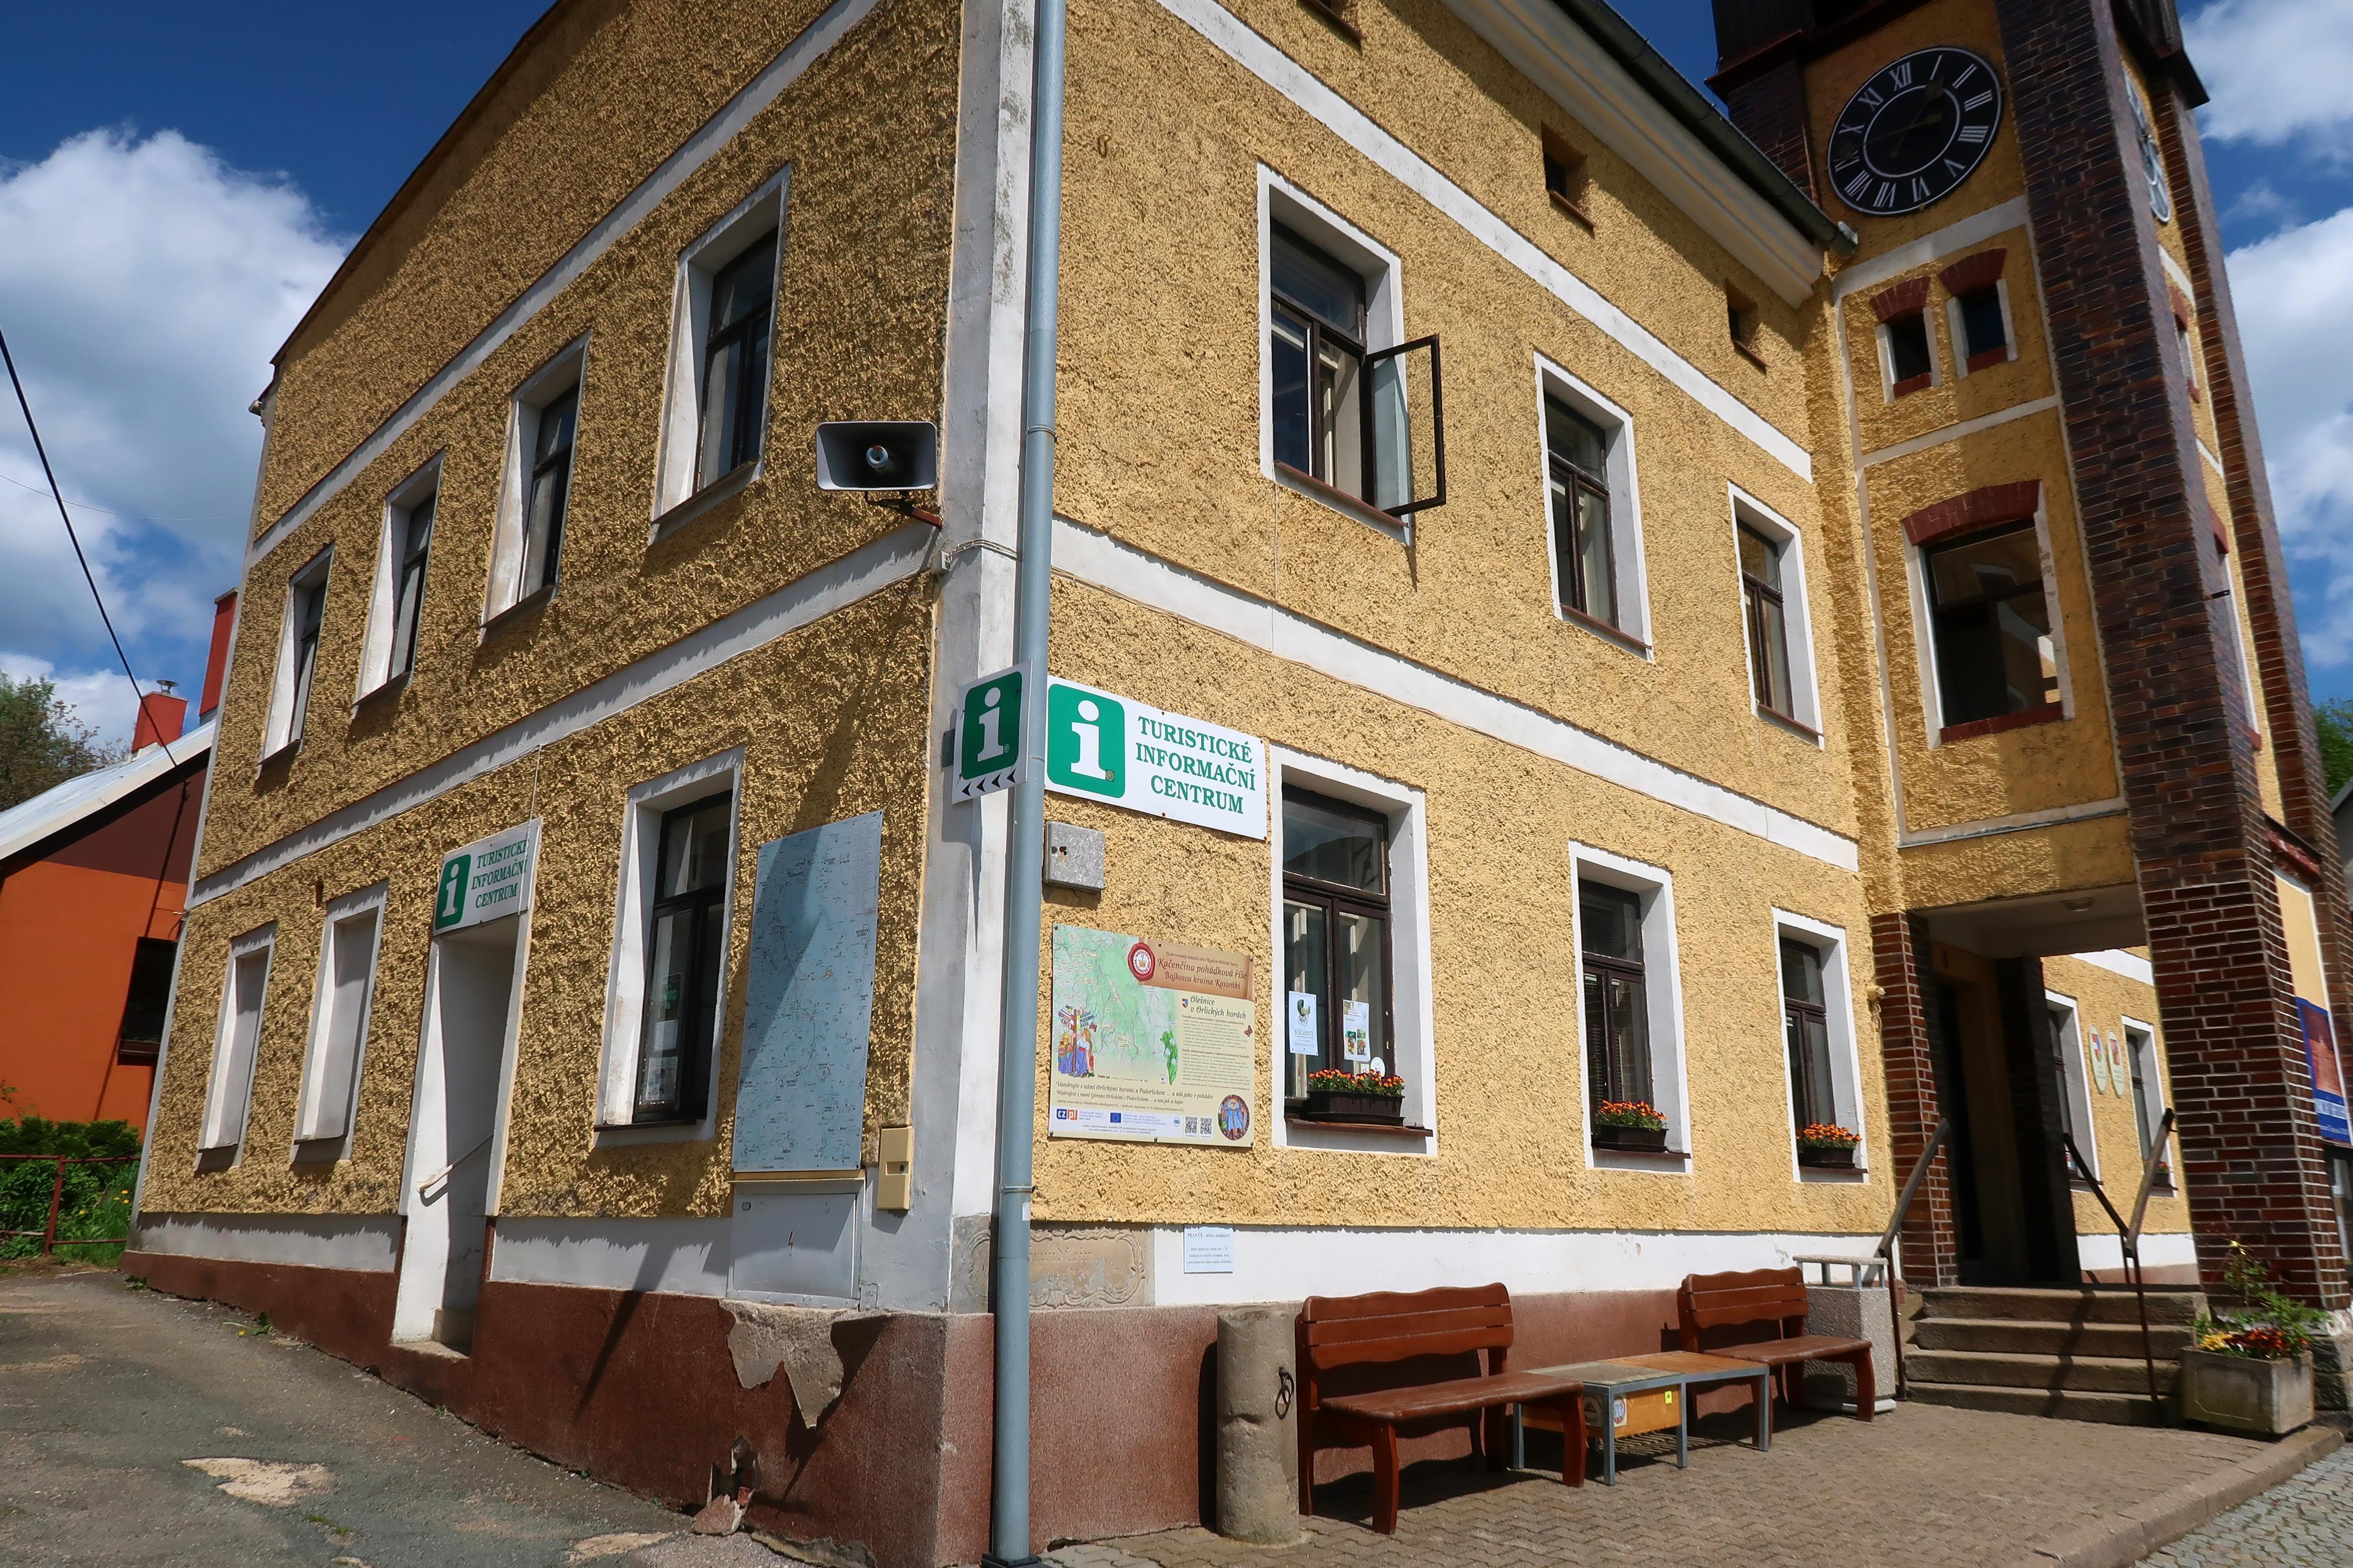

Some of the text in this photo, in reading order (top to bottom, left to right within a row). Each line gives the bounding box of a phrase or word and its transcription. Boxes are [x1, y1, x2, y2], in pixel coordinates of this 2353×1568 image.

[1888, 62, 1912, 92] XII
[1858, 87, 1885, 111] XI
[1964, 89, 1992, 112] III
[1839, 124, 1865, 134] X
[1943, 159, 1967, 177] V
[1912, 176, 1930, 203] VI
[1138, 716, 1252, 763] TURISTICKÉ
[1136, 742, 1255, 791] INFORMAČNÍ
[1151, 775, 1244, 814] CENTRUM
[475, 883, 518, 908] CENTRUM
[1158, 958, 1195, 972] Kačenčina
[1197, 964, 1233, 977] pohádková
[1235, 968, 1247, 980] říše
[1164, 971, 1241, 990] Bajkowa kraina Kasieńki
[1191, 995, 1215, 1005] Olešnice
[1197, 1006, 1224, 1017] Orlických
[1227, 1009, 1247, 1019] horách
[1056, 1081, 1079, 1089] Vandrujte
